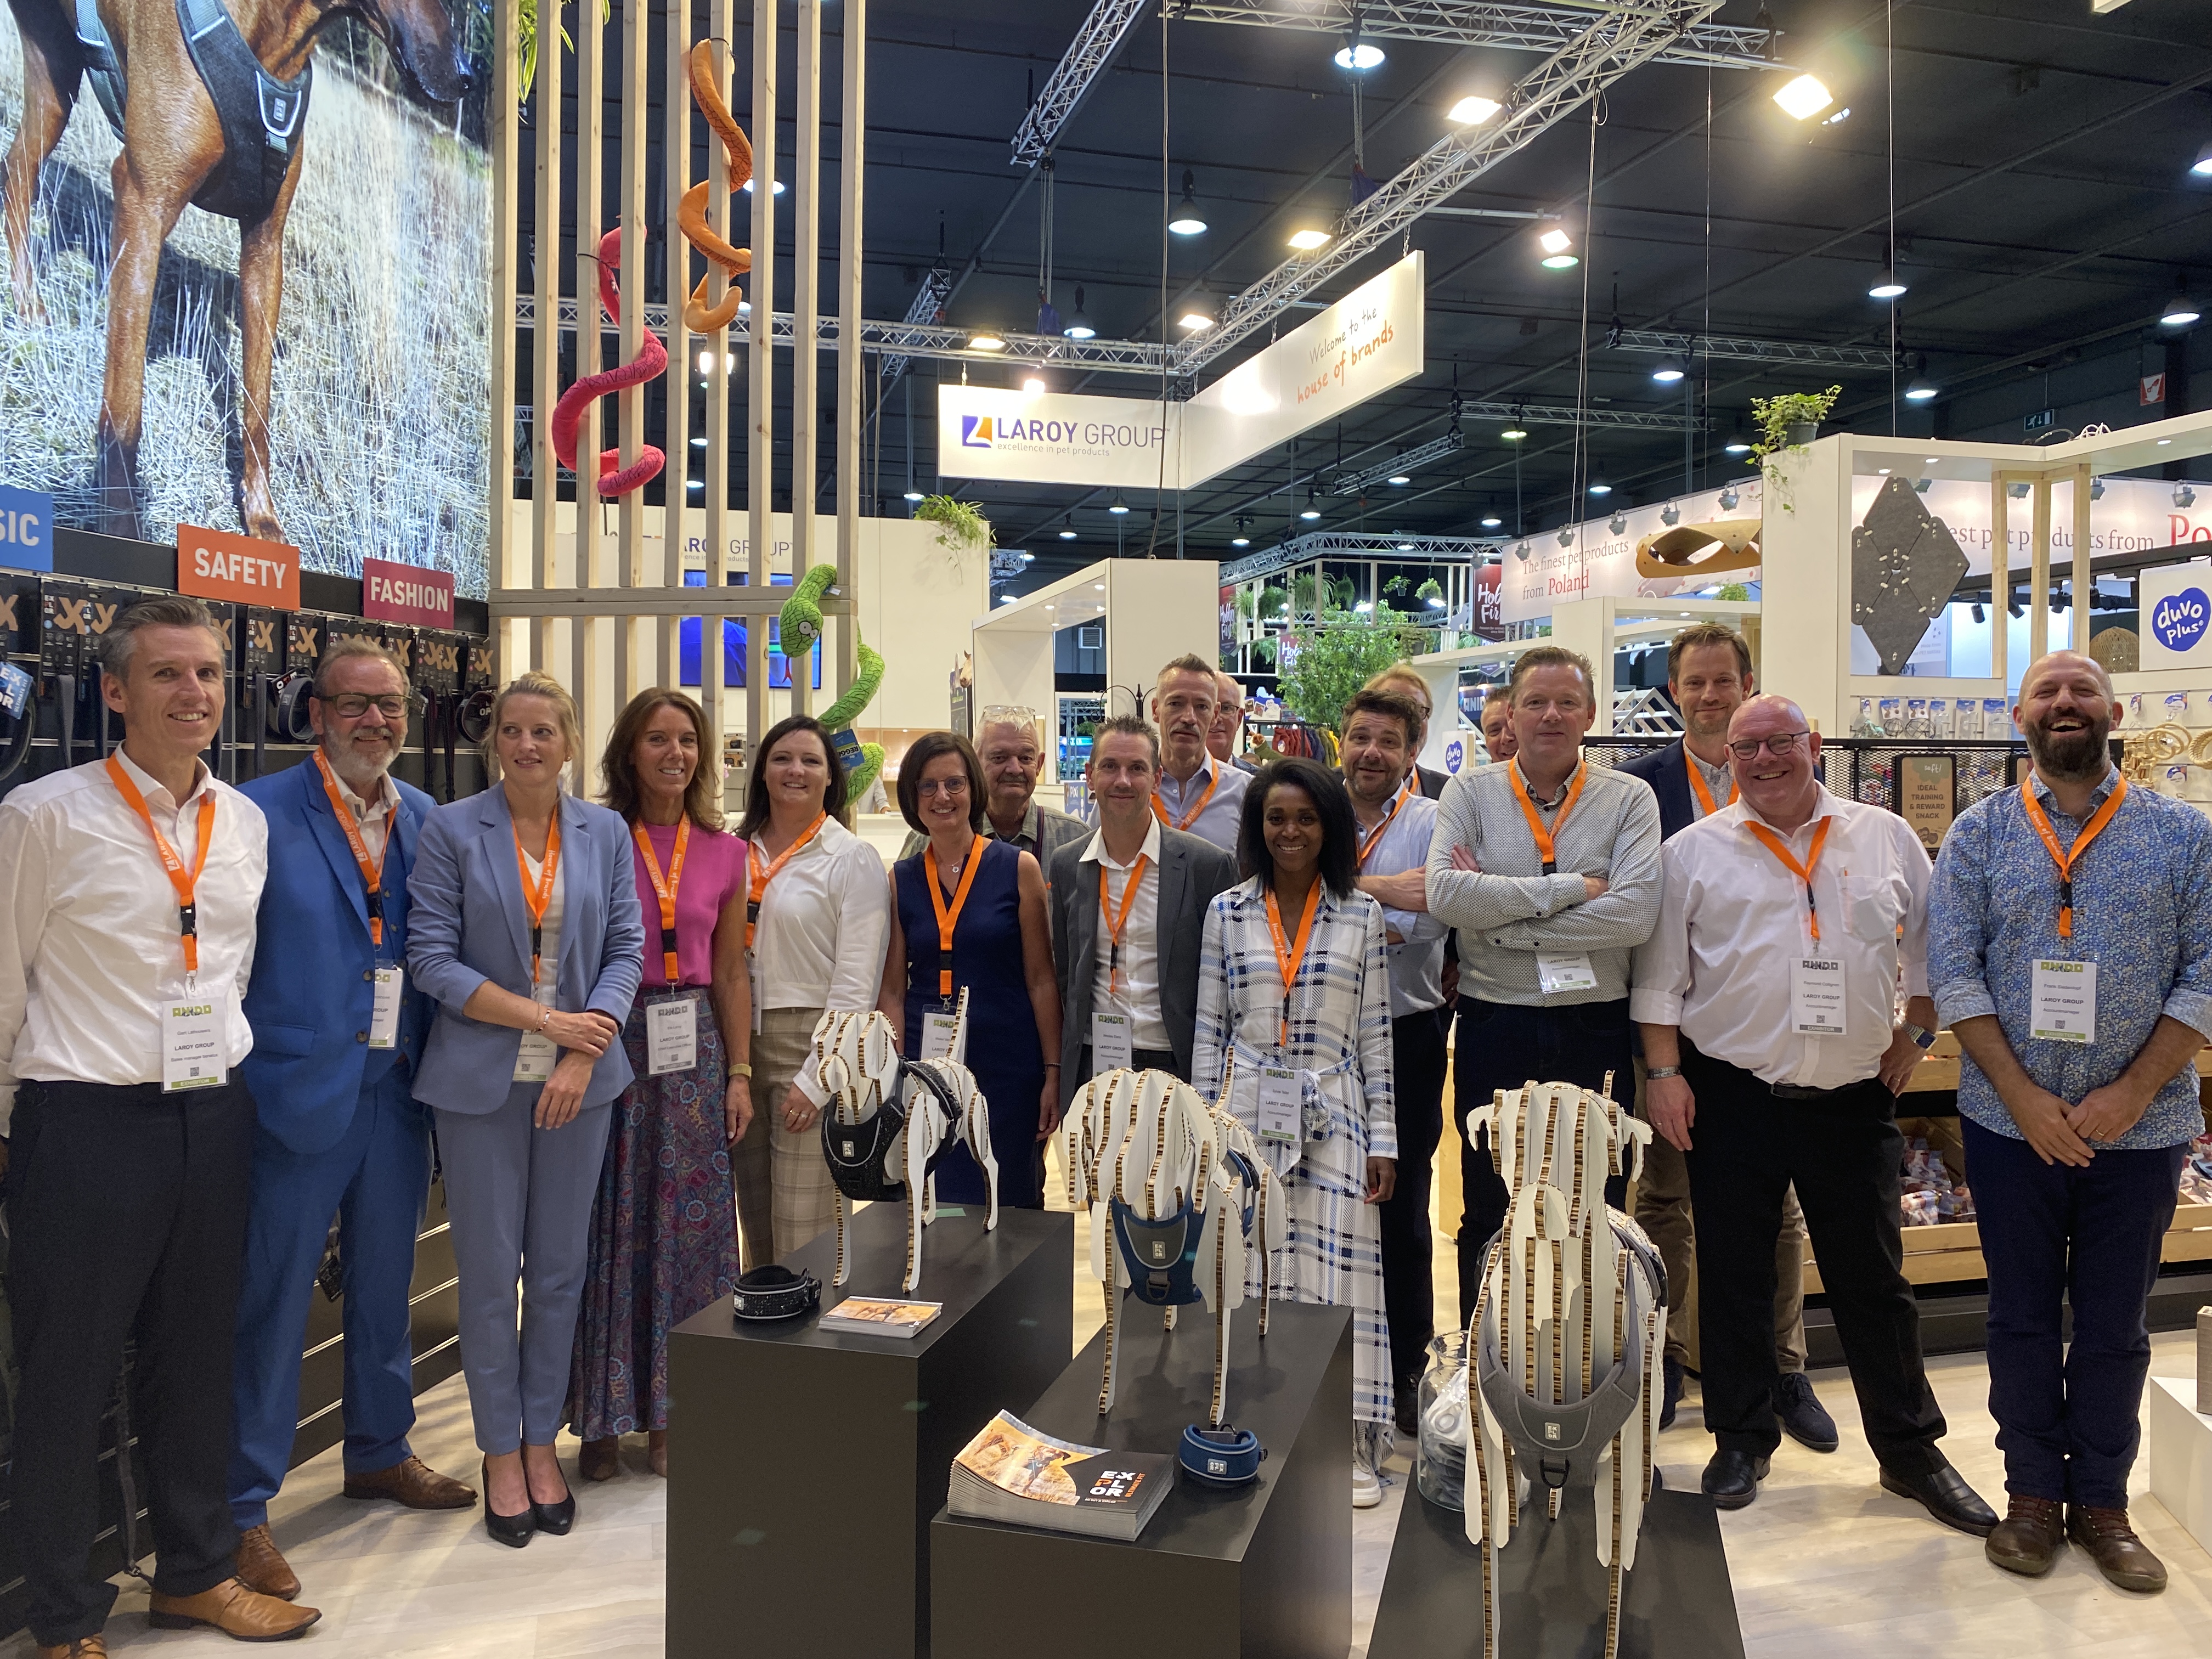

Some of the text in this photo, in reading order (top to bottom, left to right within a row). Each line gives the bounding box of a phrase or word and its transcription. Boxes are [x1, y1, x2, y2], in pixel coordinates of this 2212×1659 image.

[1310, 308, 1376, 364] Welcome to the
[1297, 319, 1393, 404] house of brands
[997, 417, 1078, 443] LAROY
[997, 442, 1043, 452] excellence
[1056, 445, 1070, 455] pet
[1073, 447, 1110, 456] products
[1981, 528, 2014, 549] pt
[2108, 529, 2153, 550] from
[195, 548, 287, 589] SAFETY
[1523, 541, 1628, 574] The finest pet products
[370, 576, 449, 612] FASHION
[1522, 568, 1589, 600] from Poland
[2158, 600, 2203, 629] duvo
[1447, 747, 1460, 761] duvo
[934, 1019, 954, 1028] ANID
[1094, 1479, 1125, 1488] PL
[1101, 1471, 1136, 1481] EX
[1090, 1487, 1123, 1497] OR
